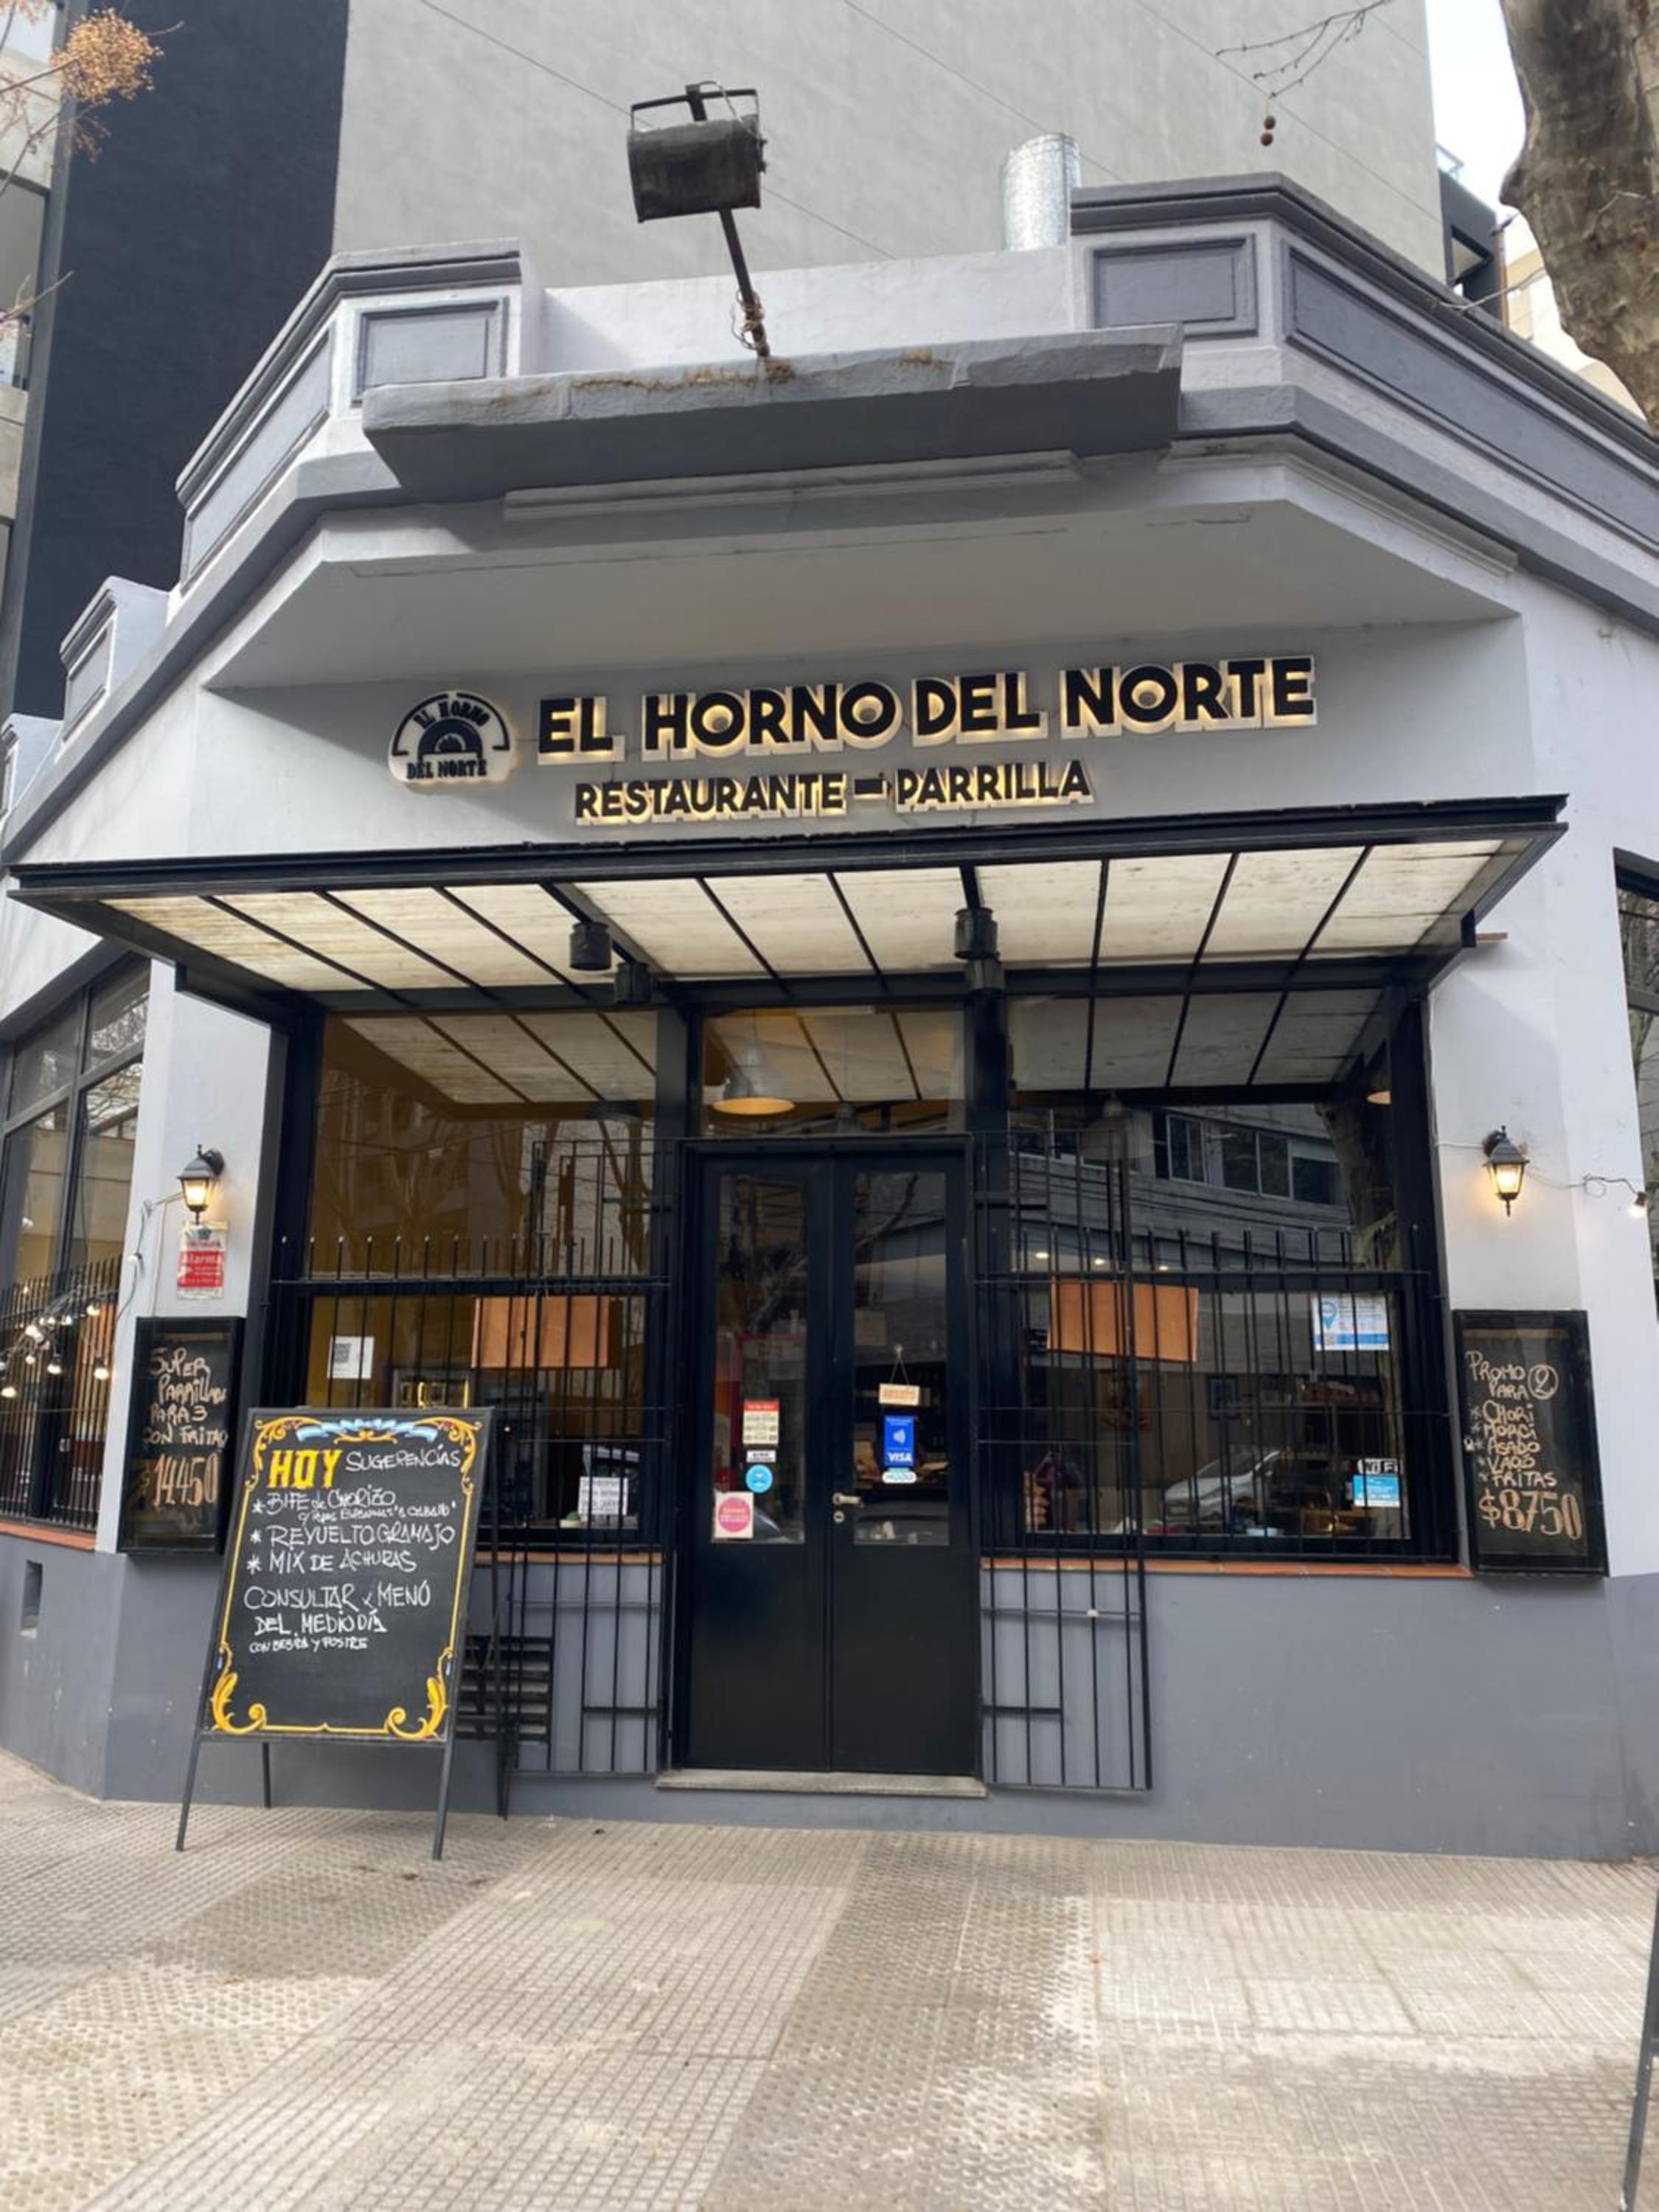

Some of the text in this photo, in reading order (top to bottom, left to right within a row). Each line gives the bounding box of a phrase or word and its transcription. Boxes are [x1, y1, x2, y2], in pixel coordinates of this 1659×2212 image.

[438, 700, 491, 727] HORNO
[539, 657, 1315, 754] EL HORNO DEL NORTE
[407, 759, 487, 779] DEL NORTE
[576, 774, 844, 818] RESTAURANTE
[898, 759, 1091, 804] PARRILLA
[150, 1347, 211, 1377] SUPER
[1464, 1351, 1526, 1381] PROMO
[1489, 1380, 1530, 1400] PARA
[150, 1403, 208, 1426] PARA 3
[144, 1423, 173, 1444] CON
[1487, 1438, 1540, 1455] ASADO
[268, 1450, 343, 1489] HOY
[887, 1452, 912, 1463] VISA
[266, 1492, 310, 1515] BIFE
[327, 1485, 396, 1509] CHORIZO
[1478, 1489, 1582, 1540] $8750
[266, 1522, 456, 1551] REVUELTO GRAMAJO
[269, 1546, 417, 1574] MIX DE ACHURAS
[244, 1583, 360, 1613] CONSULTAR
[254, 1613, 291, 1635] DEL
[321, 1636, 368, 1649] POSTRE
